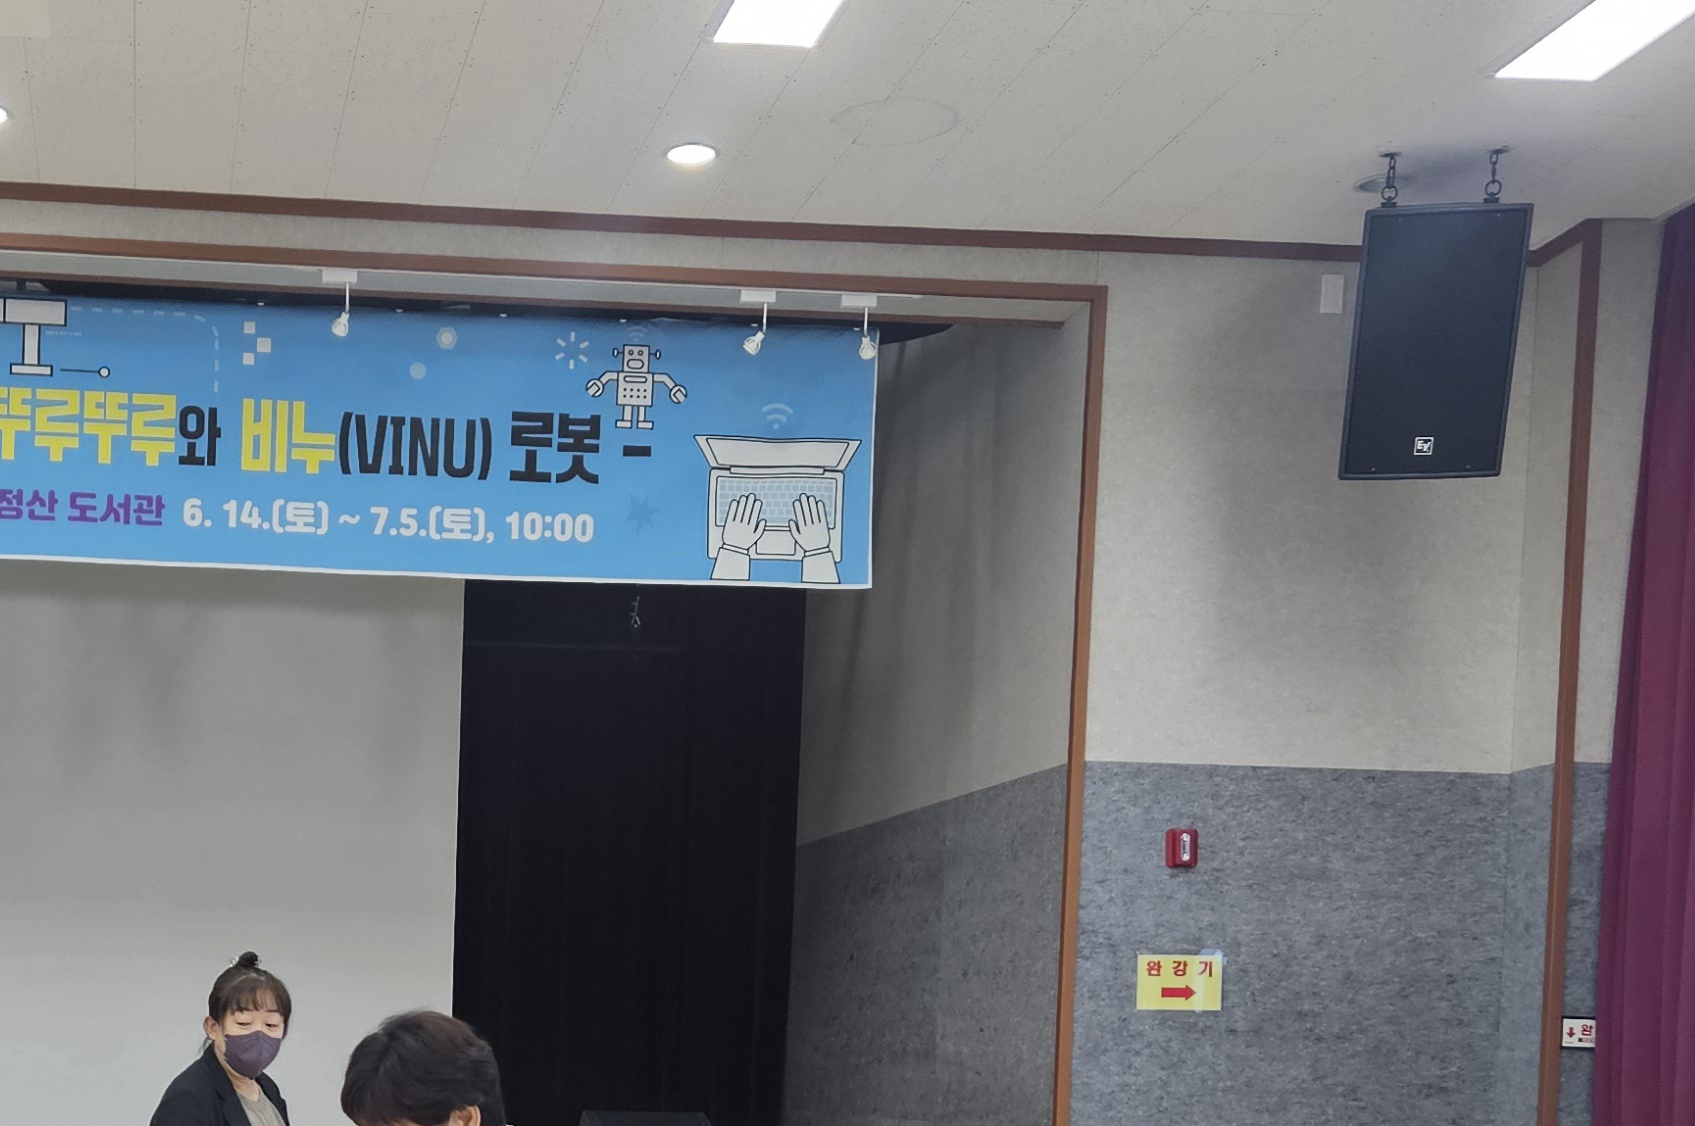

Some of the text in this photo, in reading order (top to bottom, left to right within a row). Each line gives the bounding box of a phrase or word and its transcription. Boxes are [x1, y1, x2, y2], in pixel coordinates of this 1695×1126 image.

[239, 397, 493, 481] 비누(VINU)
[508, 410, 602, 485] 로봇
[67, 490, 166, 527] 도서관
[222, 500, 330, 536] 14.(토)
[505, 511, 595, 544] 10:00
